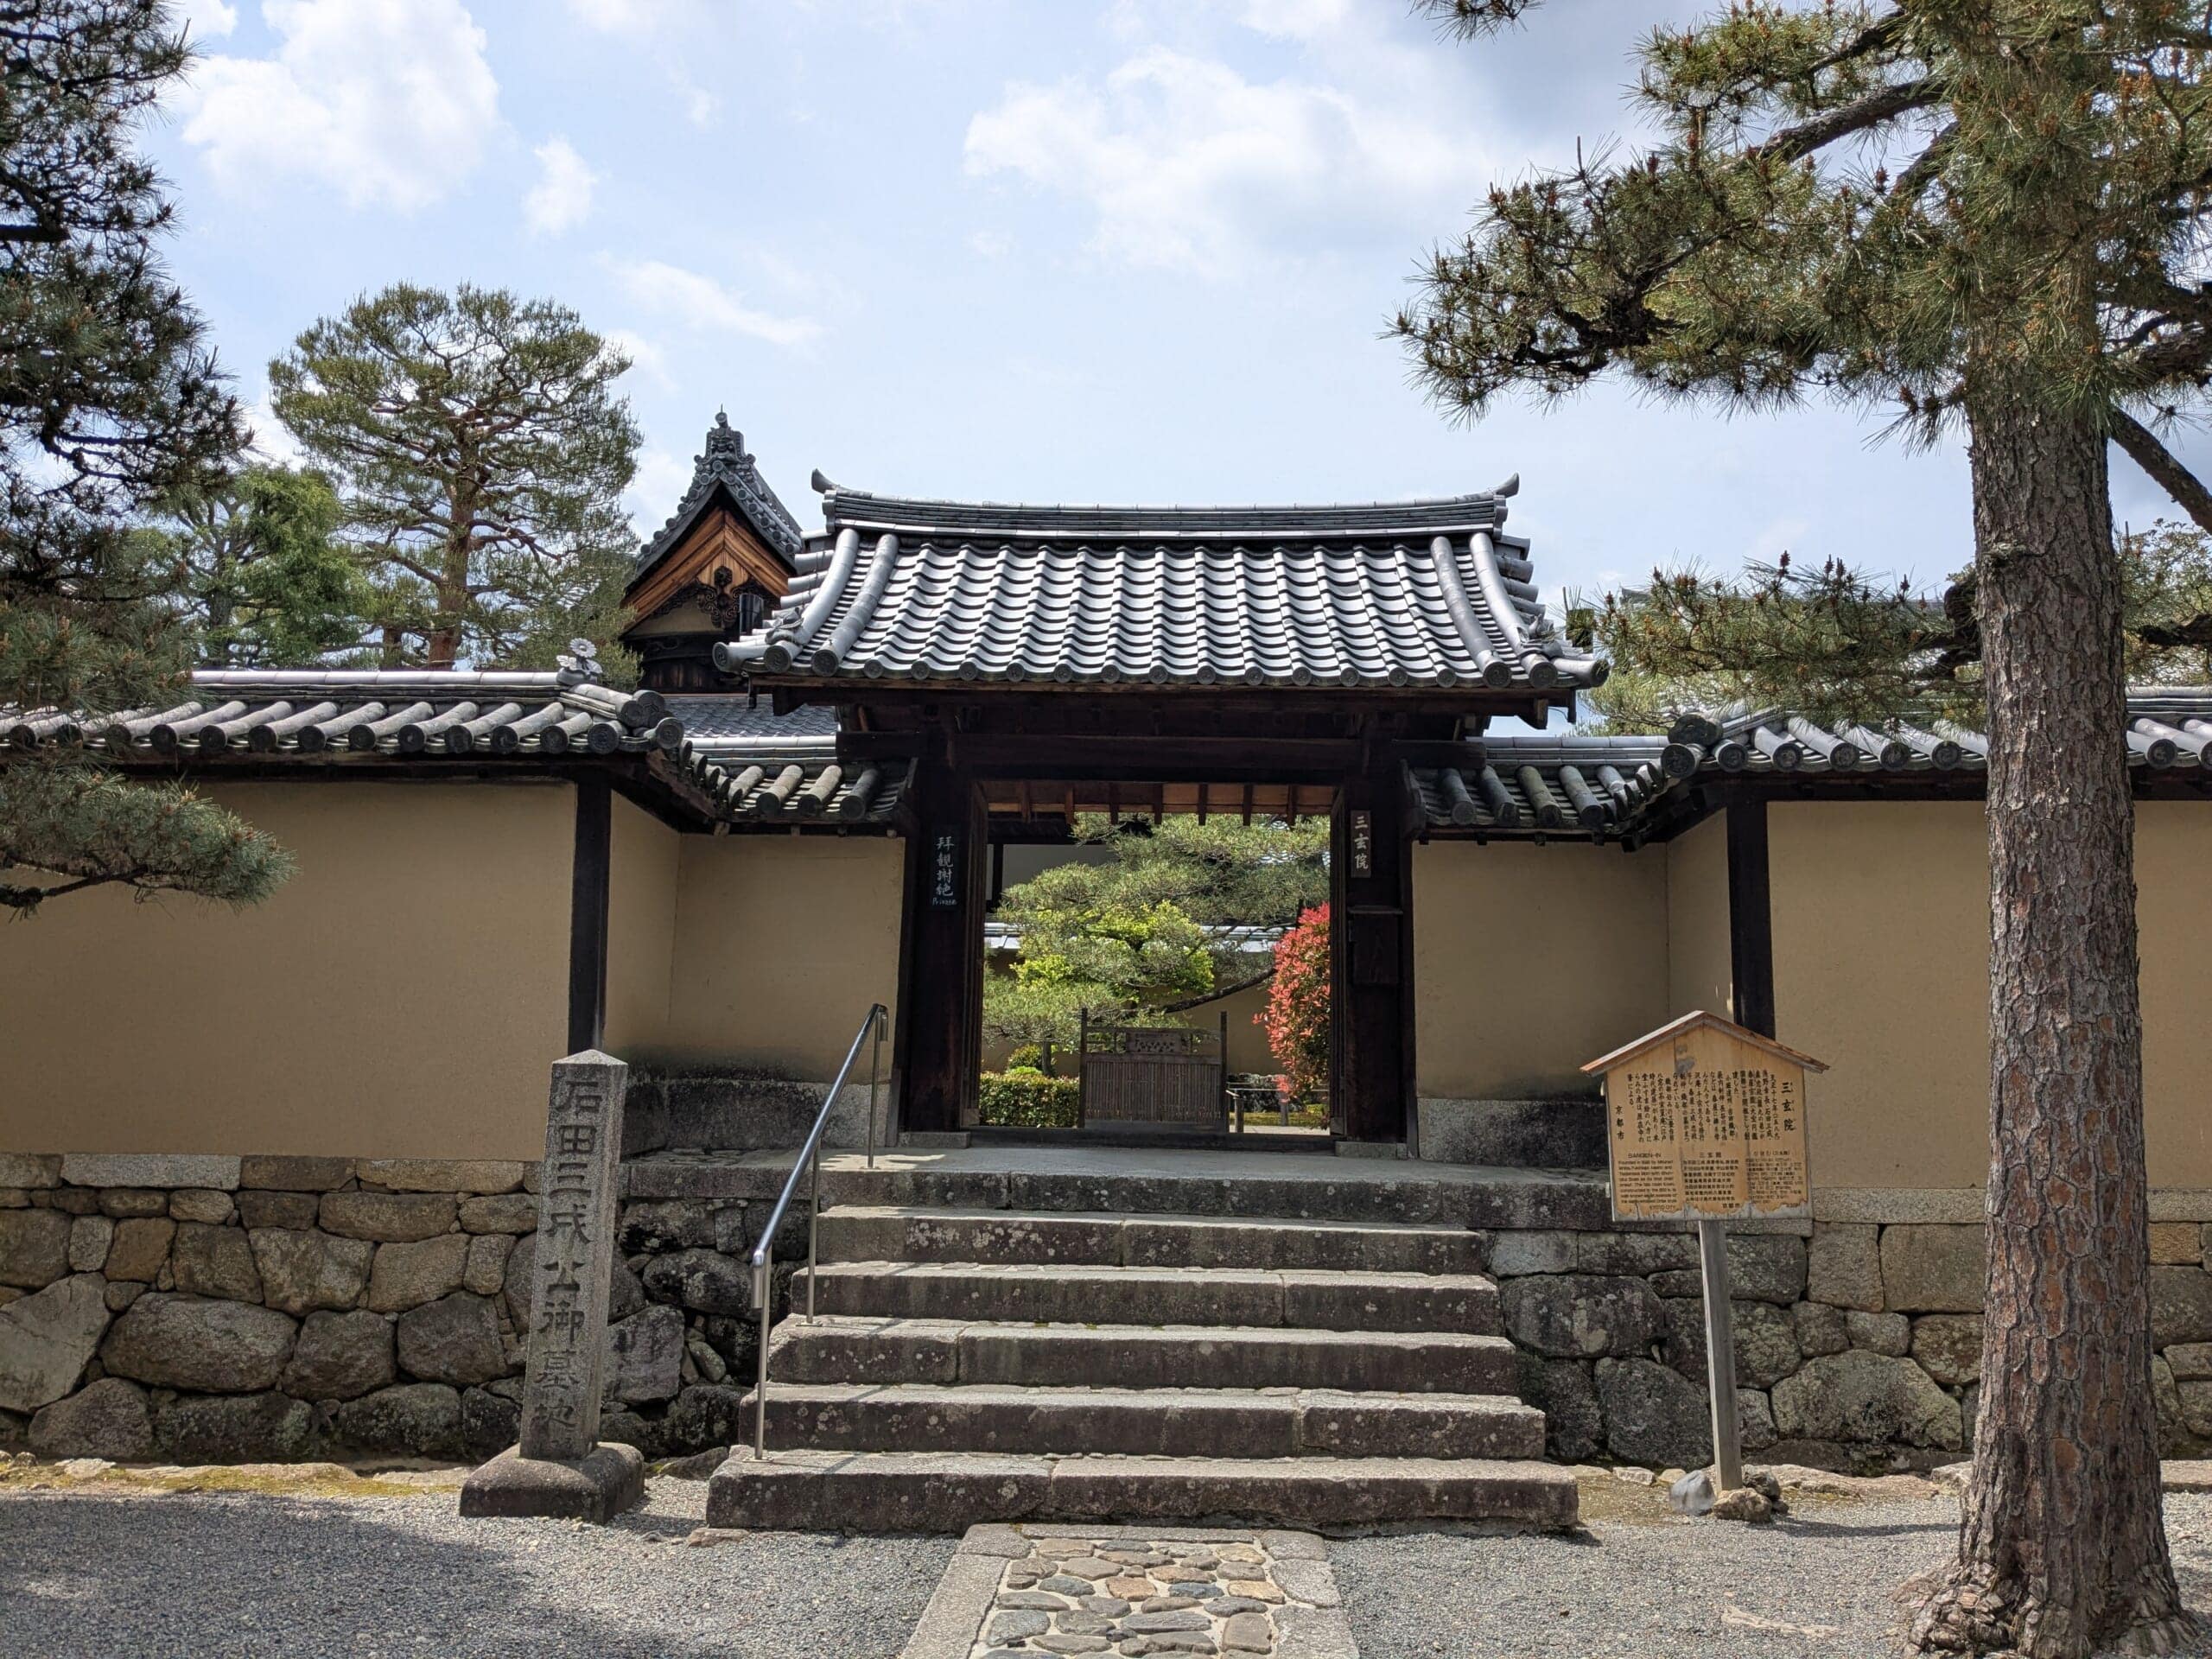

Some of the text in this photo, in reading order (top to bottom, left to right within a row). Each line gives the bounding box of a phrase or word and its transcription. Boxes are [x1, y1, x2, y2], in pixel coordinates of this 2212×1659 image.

[1354, 815, 1369, 869] 三玄院
[1615, 1105, 1624, 1141] 京都市
[1782, 1082, 1796, 1132] 三玄院
